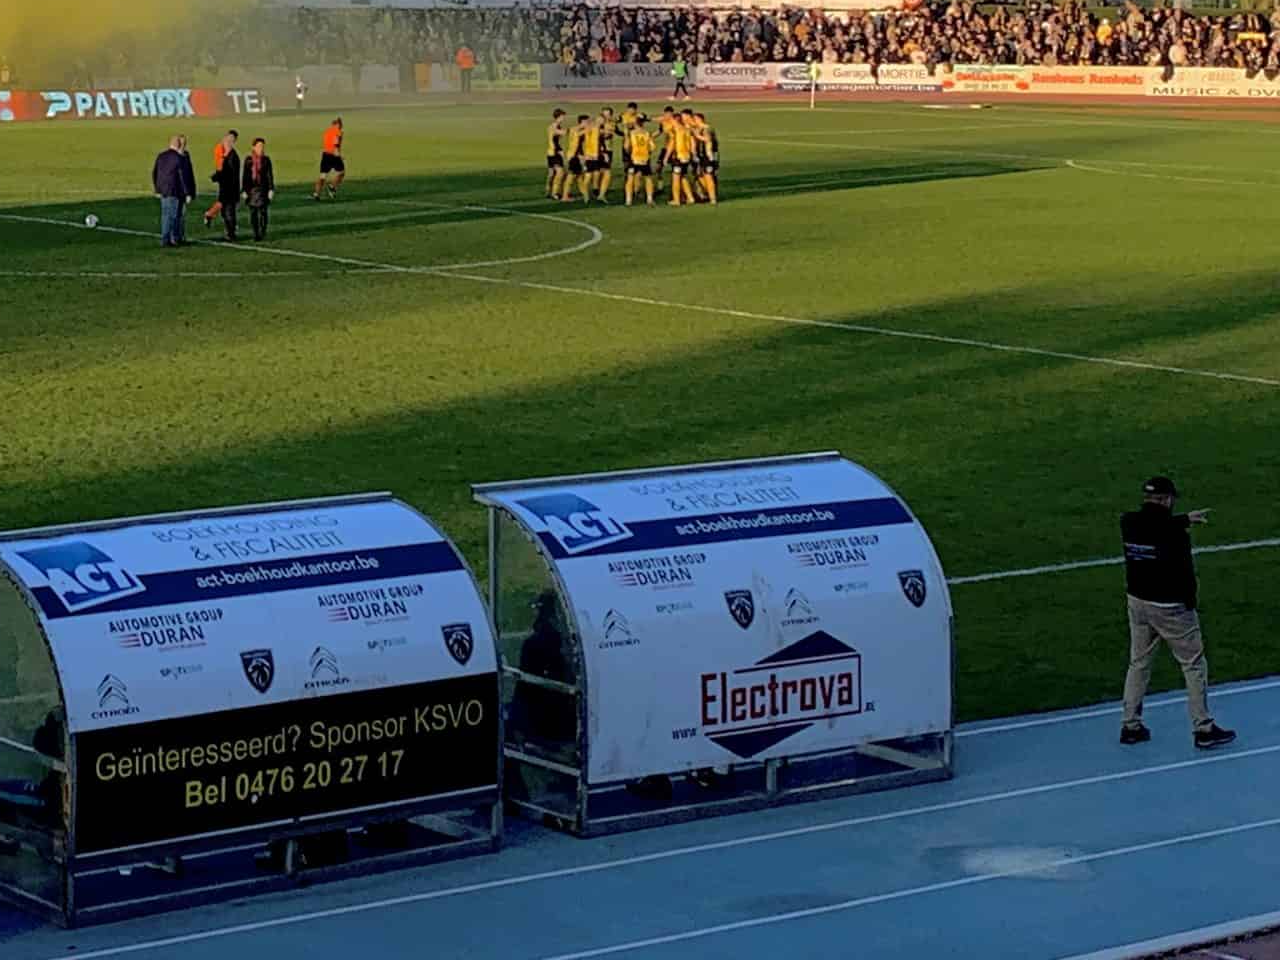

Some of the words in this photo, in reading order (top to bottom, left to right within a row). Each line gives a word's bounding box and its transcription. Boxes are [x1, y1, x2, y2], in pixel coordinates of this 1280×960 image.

[833, 67, 871, 81] Garag
[880, 67, 928, 80] MORTIE
[74, 89, 194, 117] PATRICK
[227, 90, 266, 113] TE
[543, 510, 621, 539] ACT
[193, 545, 212, 561] &
[217, 529, 345, 559] FISCALITEIT
[787, 538, 847, 554] AUTOMOTIVE
[848, 534, 879, 547] GROUP
[608, 557, 671, 574] AUTOMOTIVE
[672, 552, 707, 566] GROUP
[814, 548, 867, 567] DURAN
[46, 560, 133, 596] ACT
[196, 554, 380, 589] act-boekhoudkantoor.be
[636, 567, 692, 587] DURAN
[317, 588, 389, 607] AUTOMOTIVE
[390, 583, 424, 600] GROUP
[109, 612, 183, 633] AUTOMOTIVE
[185, 607, 224, 624] GROUP
[348, 600, 408, 622] DURAN
[140, 624, 205, 648] DURAN
[700, 671, 853, 727] Electrova
[94, 724, 301, 781] Geïnteresseerd?
[309, 715, 407, 752] Sponsor
[414, 699, 484, 734] KSVO
[184, 776, 227, 808] Bel
[235, 767, 295, 801] 0476
[303, 760, 332, 790] 20
[340, 755, 370, 783] 27
[377, 749, 406, 777] 17
